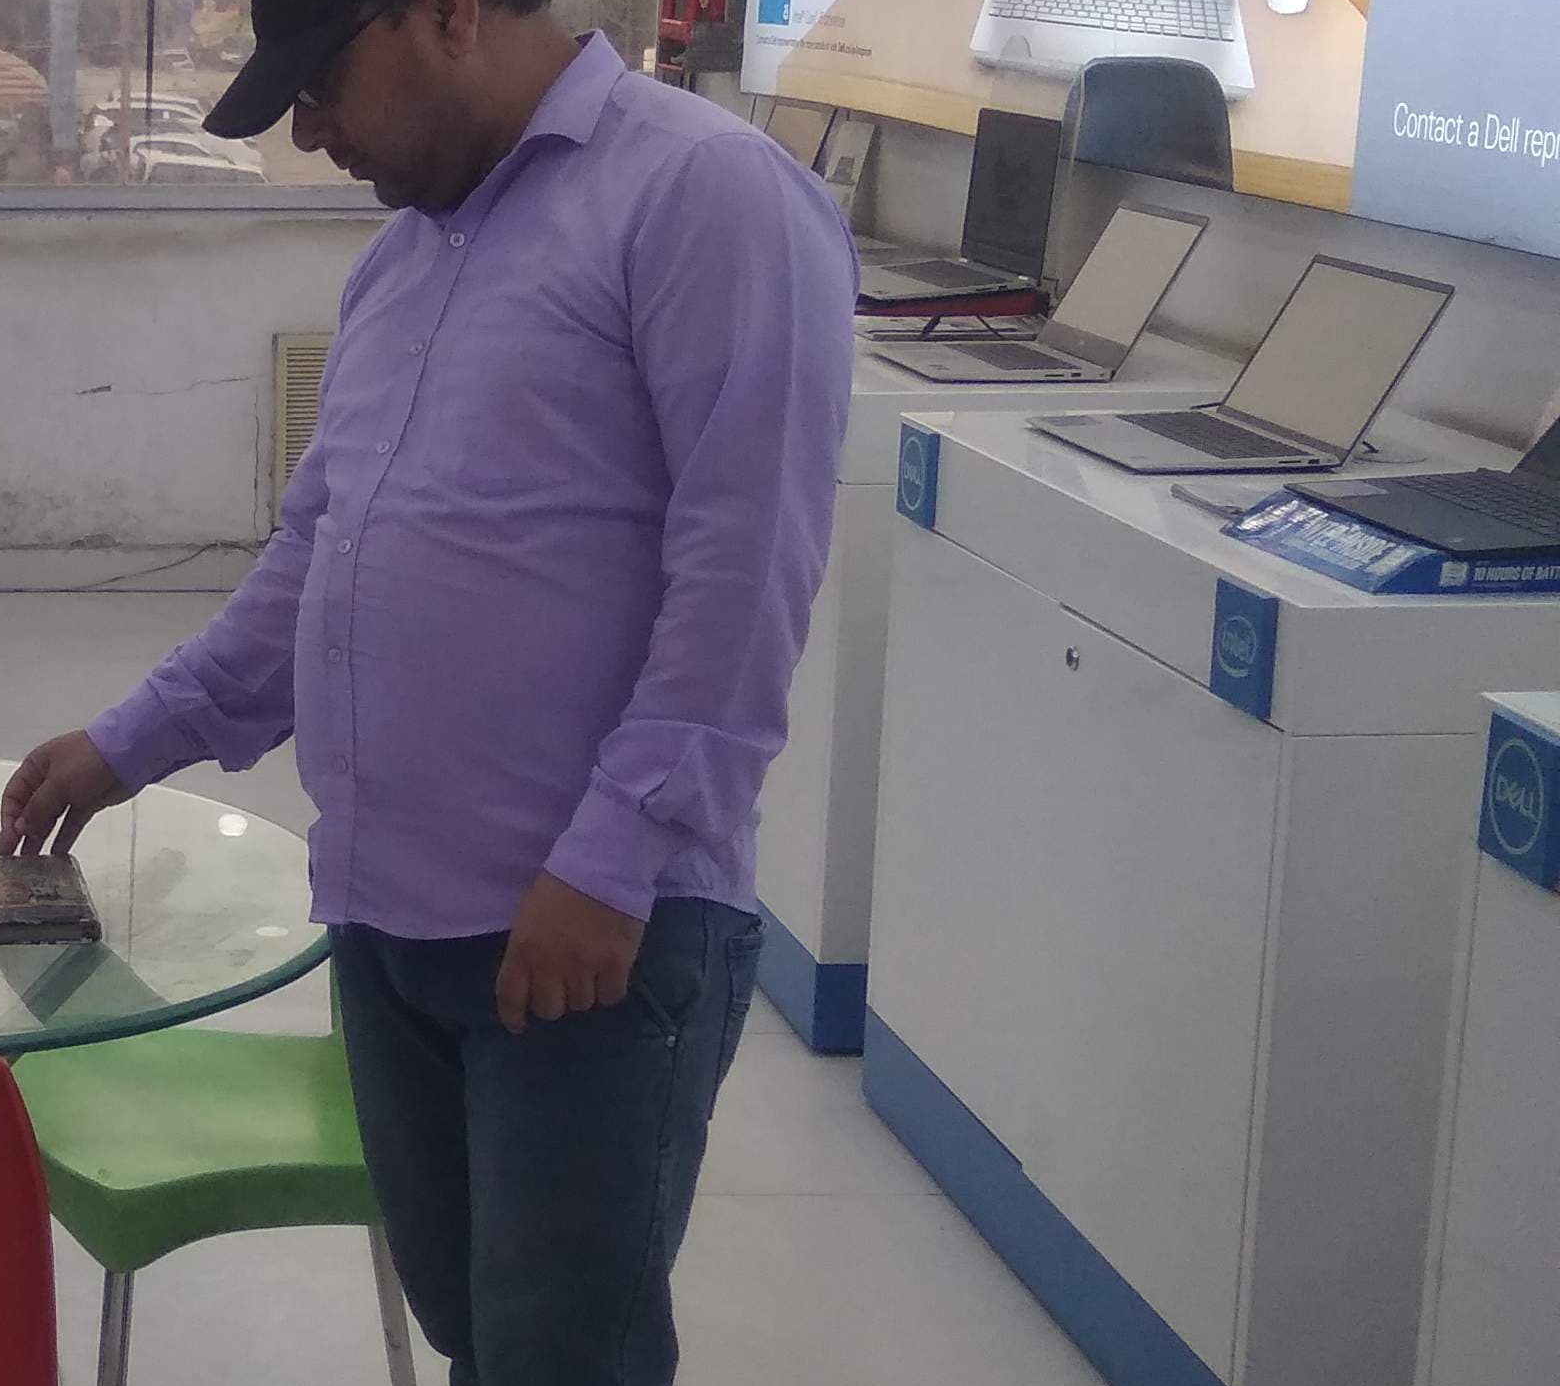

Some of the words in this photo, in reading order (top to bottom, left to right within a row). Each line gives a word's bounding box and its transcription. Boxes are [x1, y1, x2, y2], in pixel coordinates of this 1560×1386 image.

[1393, 102, 1464, 145] Contact
[1468, 121, 1479, 147] a
[1484, 113, 1520, 154] Dell
[1495, 774, 1538, 821] DELL
